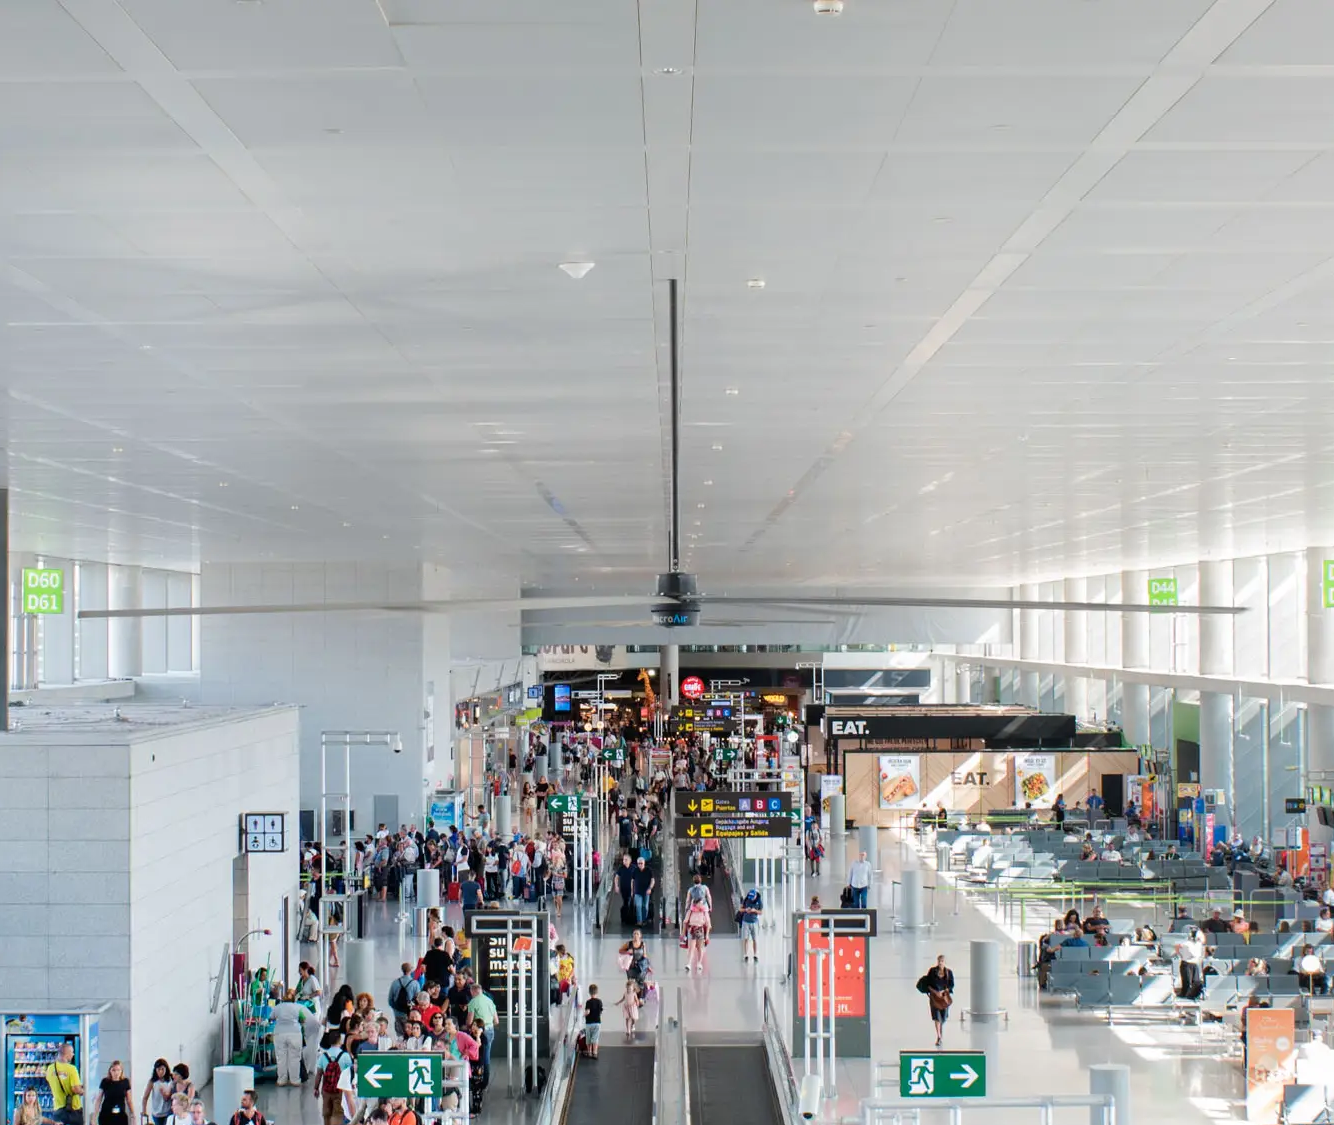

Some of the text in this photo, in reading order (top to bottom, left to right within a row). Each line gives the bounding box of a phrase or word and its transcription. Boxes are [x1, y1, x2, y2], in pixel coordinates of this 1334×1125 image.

[28, 572, 60, 589] D60
[1152, 582, 1175, 594] D44
[28, 593, 58, 611] D61
[832, 720, 870, 735] EAT.
[951, 772, 990, 786] EAT.
[741, 800, 778, 809] A B C
[489, 948, 504, 958] su
[490, 960, 532, 970] mara
